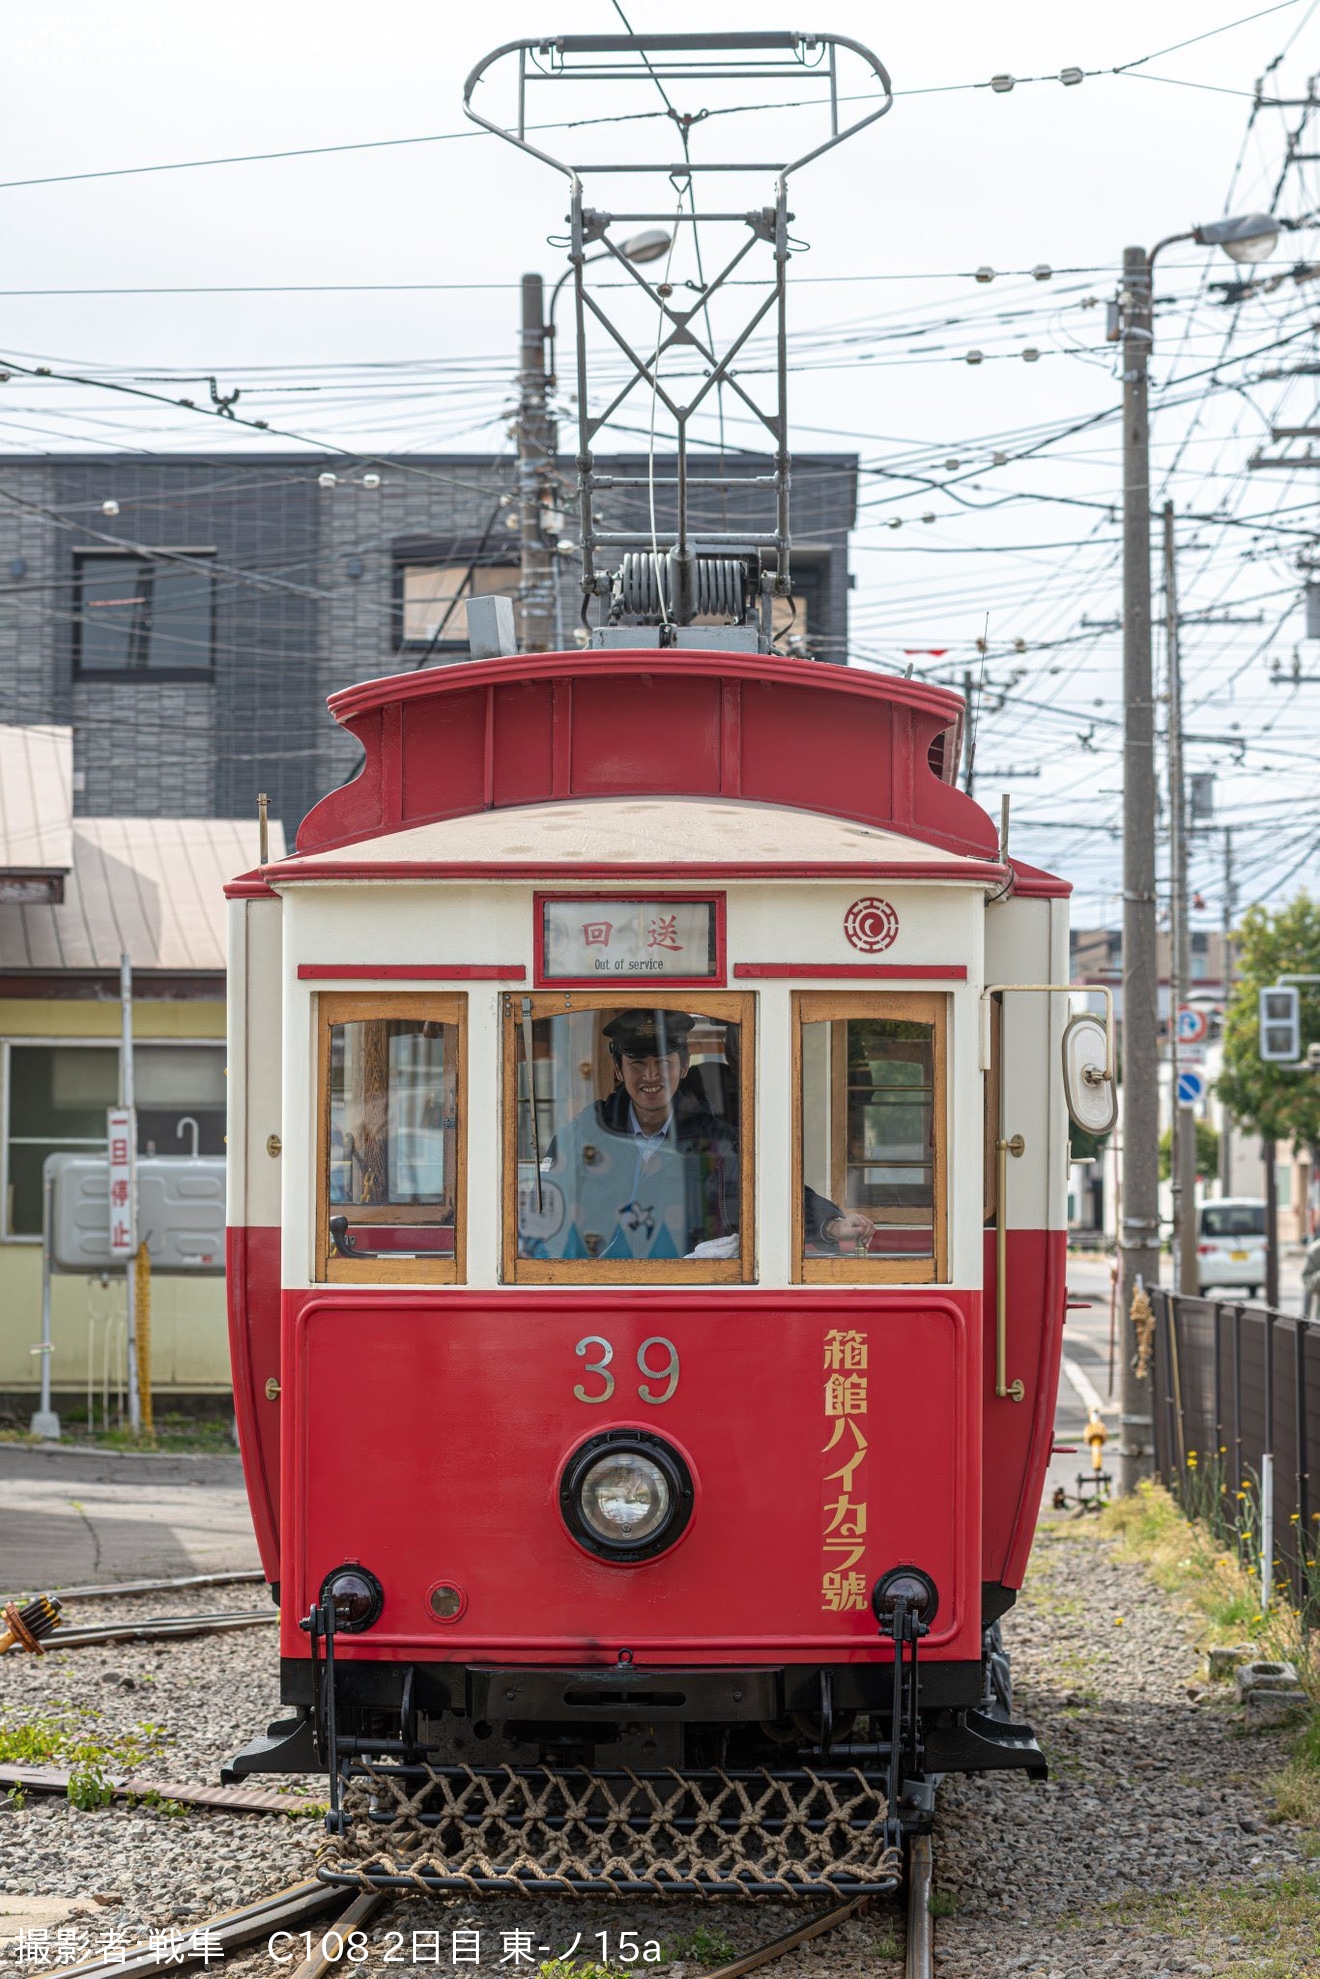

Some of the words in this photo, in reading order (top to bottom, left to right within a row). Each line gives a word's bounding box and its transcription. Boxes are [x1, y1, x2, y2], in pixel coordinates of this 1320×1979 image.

[582, 915, 683, 951] 回送
[595, 959, 610, 970] Out
[614, 959, 624, 970] of
[628, 959, 663, 970] service
[573, 1335, 679, 1404] 39
[821, 1329, 868, 1612] 箱館ハイカラ號
